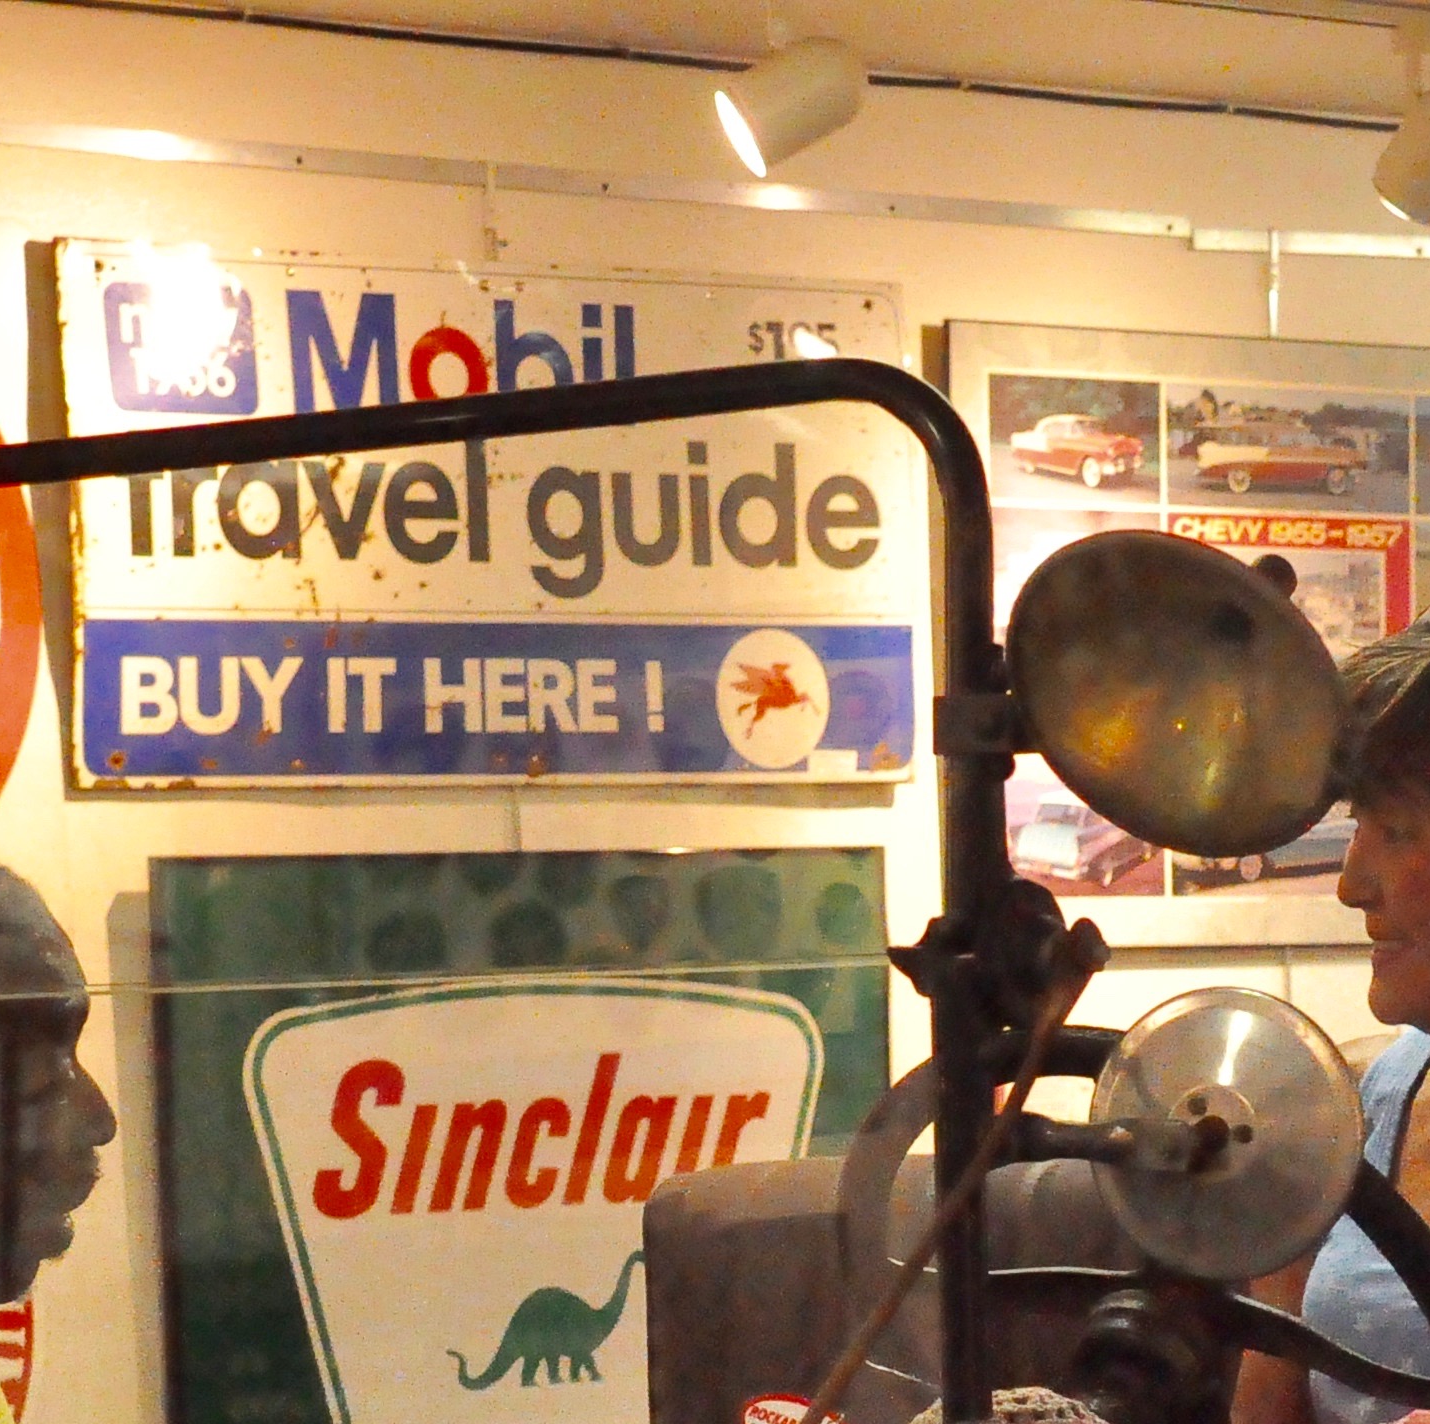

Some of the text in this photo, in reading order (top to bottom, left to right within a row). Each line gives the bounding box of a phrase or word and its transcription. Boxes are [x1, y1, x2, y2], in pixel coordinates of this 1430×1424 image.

[286, 288, 637, 414] Mobil
[117, 430, 882, 598] Travel guide
[1172, 515, 1264, 545] CHEVY
[120, 655, 303, 736] BUY
[327, 657, 419, 735] IT
[424, 657, 619, 736] HERE
[312, 1052, 771, 1221] Sinclair
